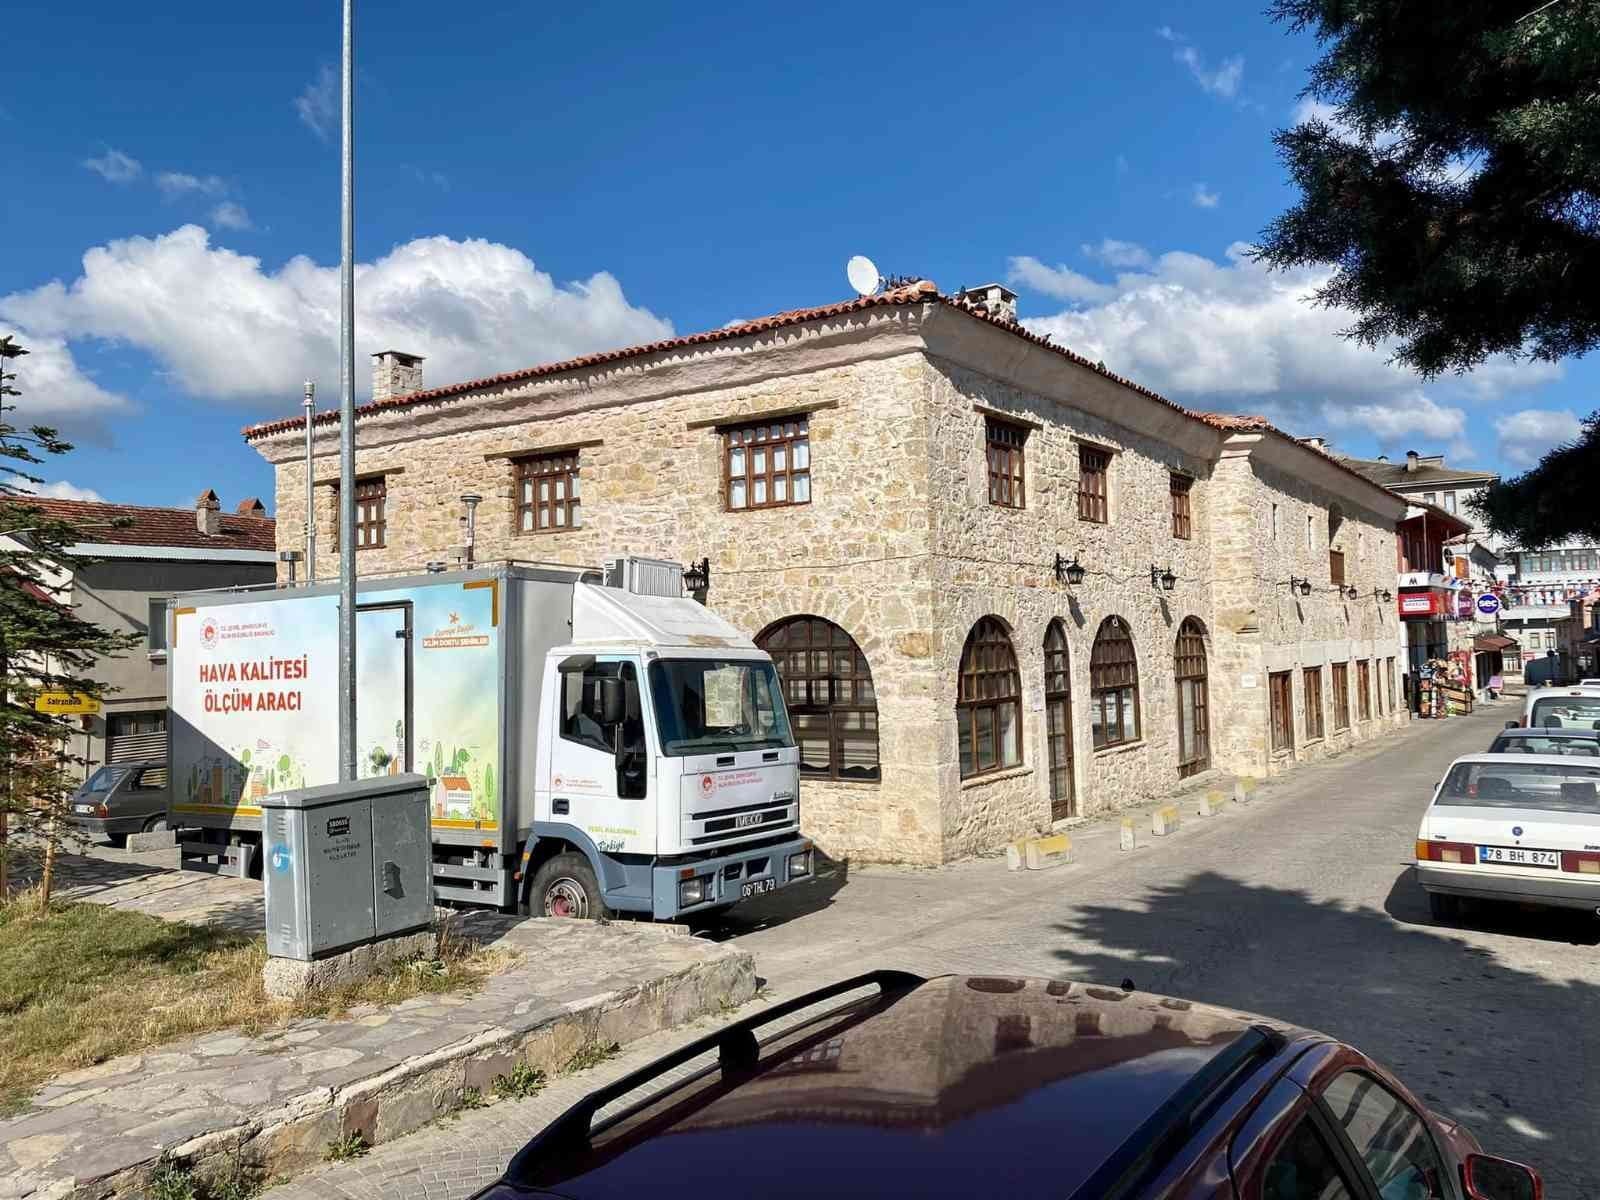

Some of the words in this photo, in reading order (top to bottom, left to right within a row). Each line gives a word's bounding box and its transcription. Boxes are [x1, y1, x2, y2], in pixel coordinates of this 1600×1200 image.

[200, 663, 237, 682] HAVA
[240, 654, 308, 681] KALİTESİ
[204, 688, 253, 715] ÖLÇÜM
[256, 691, 301, 711] ARACI
[736, 814, 763, 828] IVECO
[1487, 848, 1503, 860] 78
[1509, 850, 1525, 862] BH
[1532, 852, 1555, 864] 874
